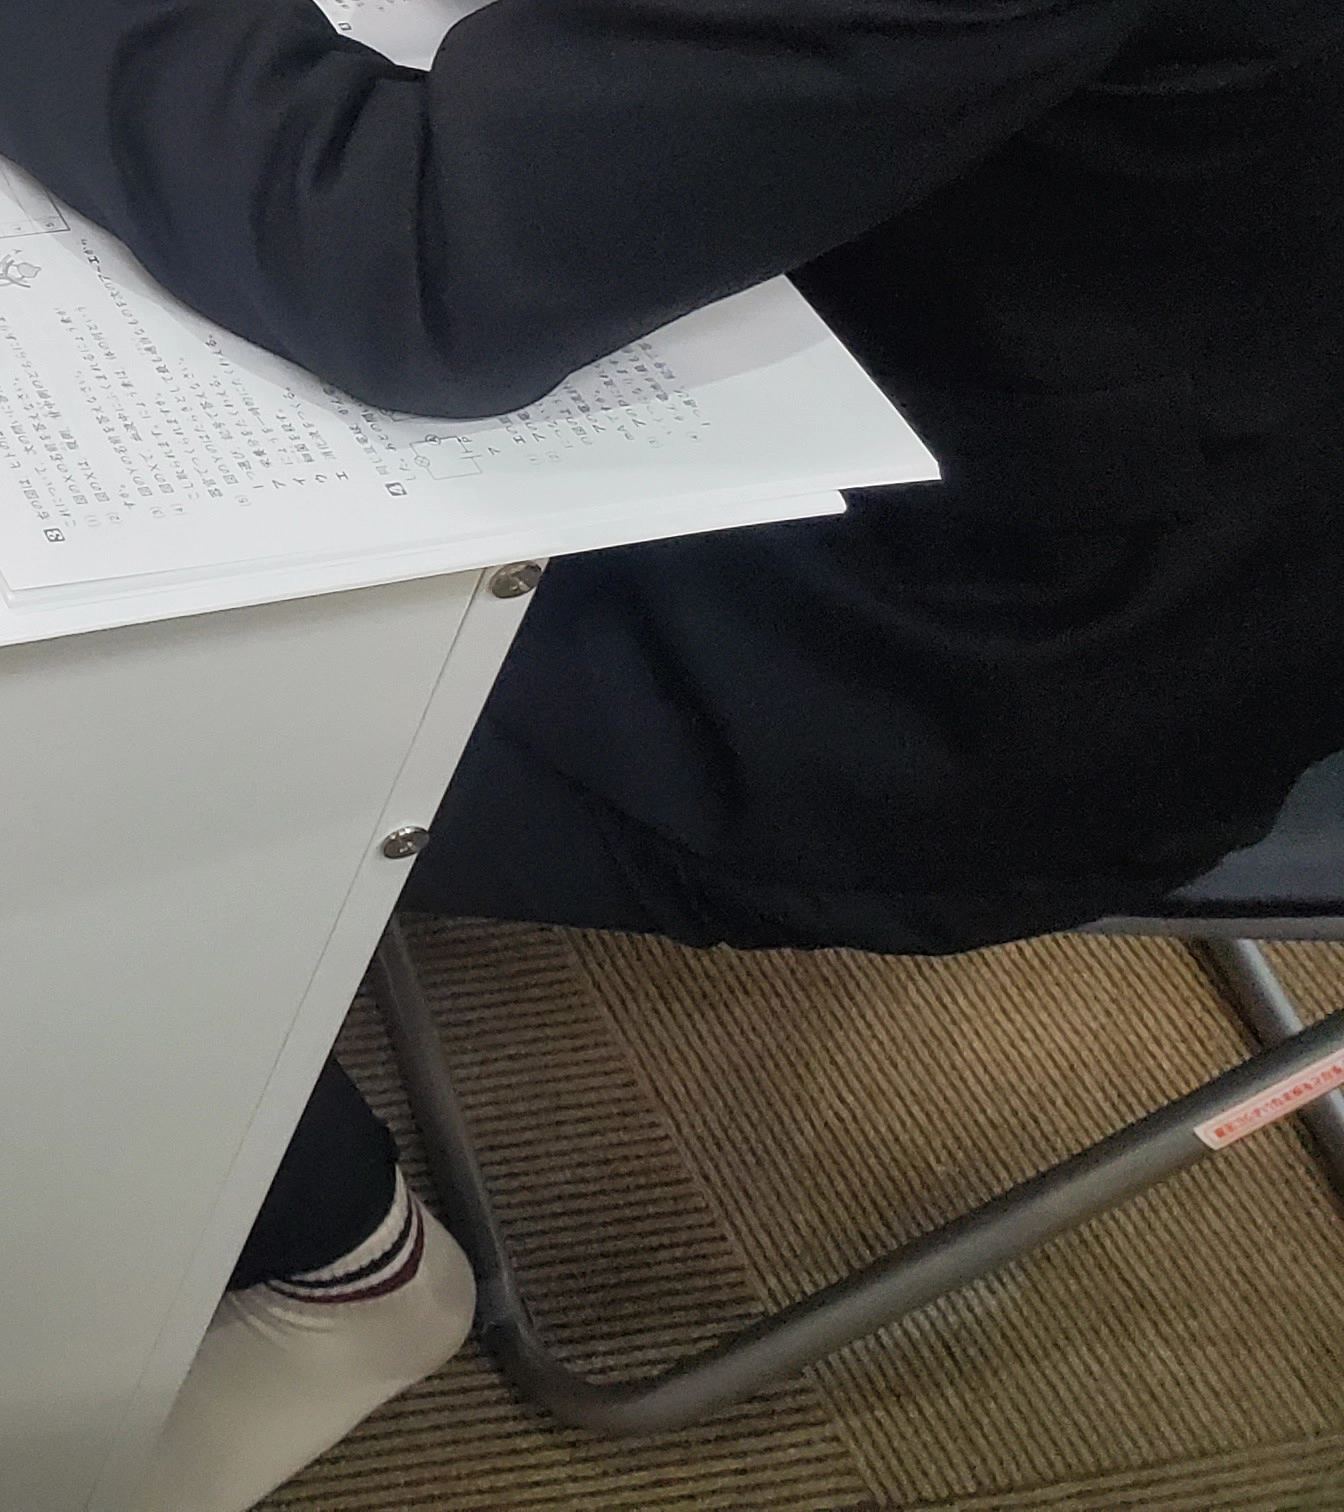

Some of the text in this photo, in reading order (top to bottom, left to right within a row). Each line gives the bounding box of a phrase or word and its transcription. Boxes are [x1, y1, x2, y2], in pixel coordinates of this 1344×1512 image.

[8, 375, 87, 506] 図のXの名前を答えなさい。
[70, 368, 152, 497] 図のYの名前を答えなさい。
[151, 391, 223, 499] 器官でつくられますか。
[42, 527, 65, 543] 3
[114, 483, 136, 510] すか。
